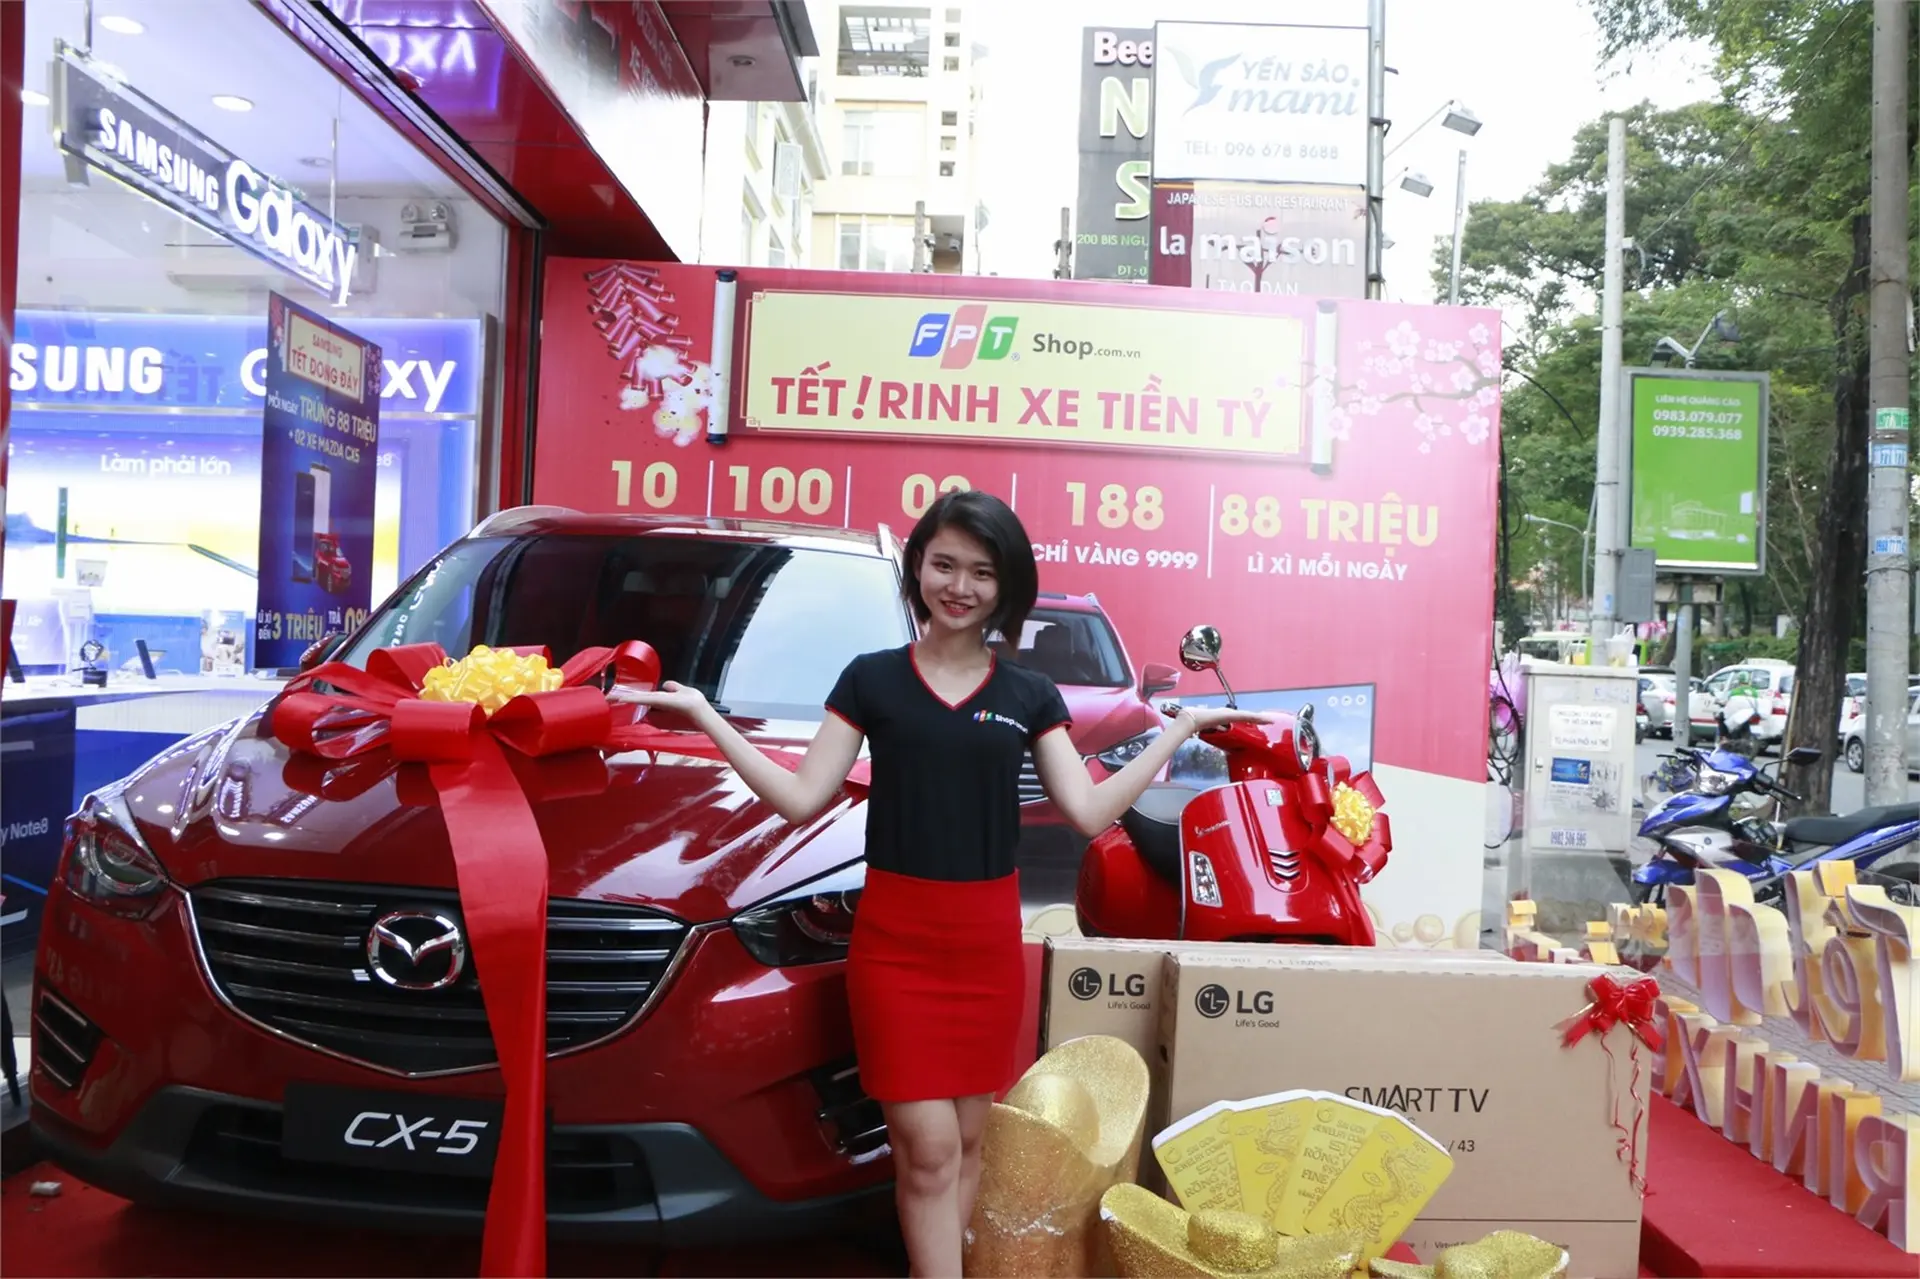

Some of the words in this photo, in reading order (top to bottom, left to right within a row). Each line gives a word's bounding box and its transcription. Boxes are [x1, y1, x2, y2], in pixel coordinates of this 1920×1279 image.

[1228, 78, 1360, 116] mami
[1225, 142, 1255, 158] 096
[1262, 143, 1292, 159] 678
[100, 108, 219, 211] SAMSUNG
[226, 160, 355, 306] Galaxy
[1077, 234, 1098, 245] 200
[1101, 234, 1118, 246] BIS
[1160, 226, 1186, 255] la
[1200, 223, 1355, 267] maison
[292, 345, 308, 371] TẾT
[879, 381, 999, 423] RINH
[1017, 387, 1080, 428] XE
[1097, 373, 1199, 435] TIỀN
[1217, 387, 1272, 439] TỶ
[1653, 409, 1743, 424] 0983.079.077
[337, 410, 350, 433] 88
[1652, 425, 1743, 440] 0939.285.368
[100, 452, 146, 472] Làm
[150, 453, 196, 476] phải
[200, 455, 231, 475] lớn
[612, 460, 678, 509] 10
[729, 465, 833, 515] 100
[1065, 481, 1164, 531] 188
[1219, 493, 1282, 538] 88
[1301, 492, 1439, 557] TRIỆU
[1074, 542, 1140, 568] VÀNG
[1145, 550, 1199, 570] 9999
[1247, 553, 1268, 573] LÌ
[1270, 553, 1292, 575] XÌ
[1299, 552, 1341, 578] MỖI
[1347, 560, 1408, 582] NGÀY
[10, 817, 48, 840] Note8
[1108, 973, 1145, 996] LG
[1107, 1000, 1128, 1010] Life's
[1129, 1001, 1151, 1010] Good
[1236, 990, 1274, 1014] LG
[1235, 1019, 1256, 1028] Life's
[1257, 1019, 1280, 1028] Good
[1448, 1088, 1489, 1113] TV
[344, 1111, 489, 1154] CX-5
[1458, 1139, 1475, 1152] 43
